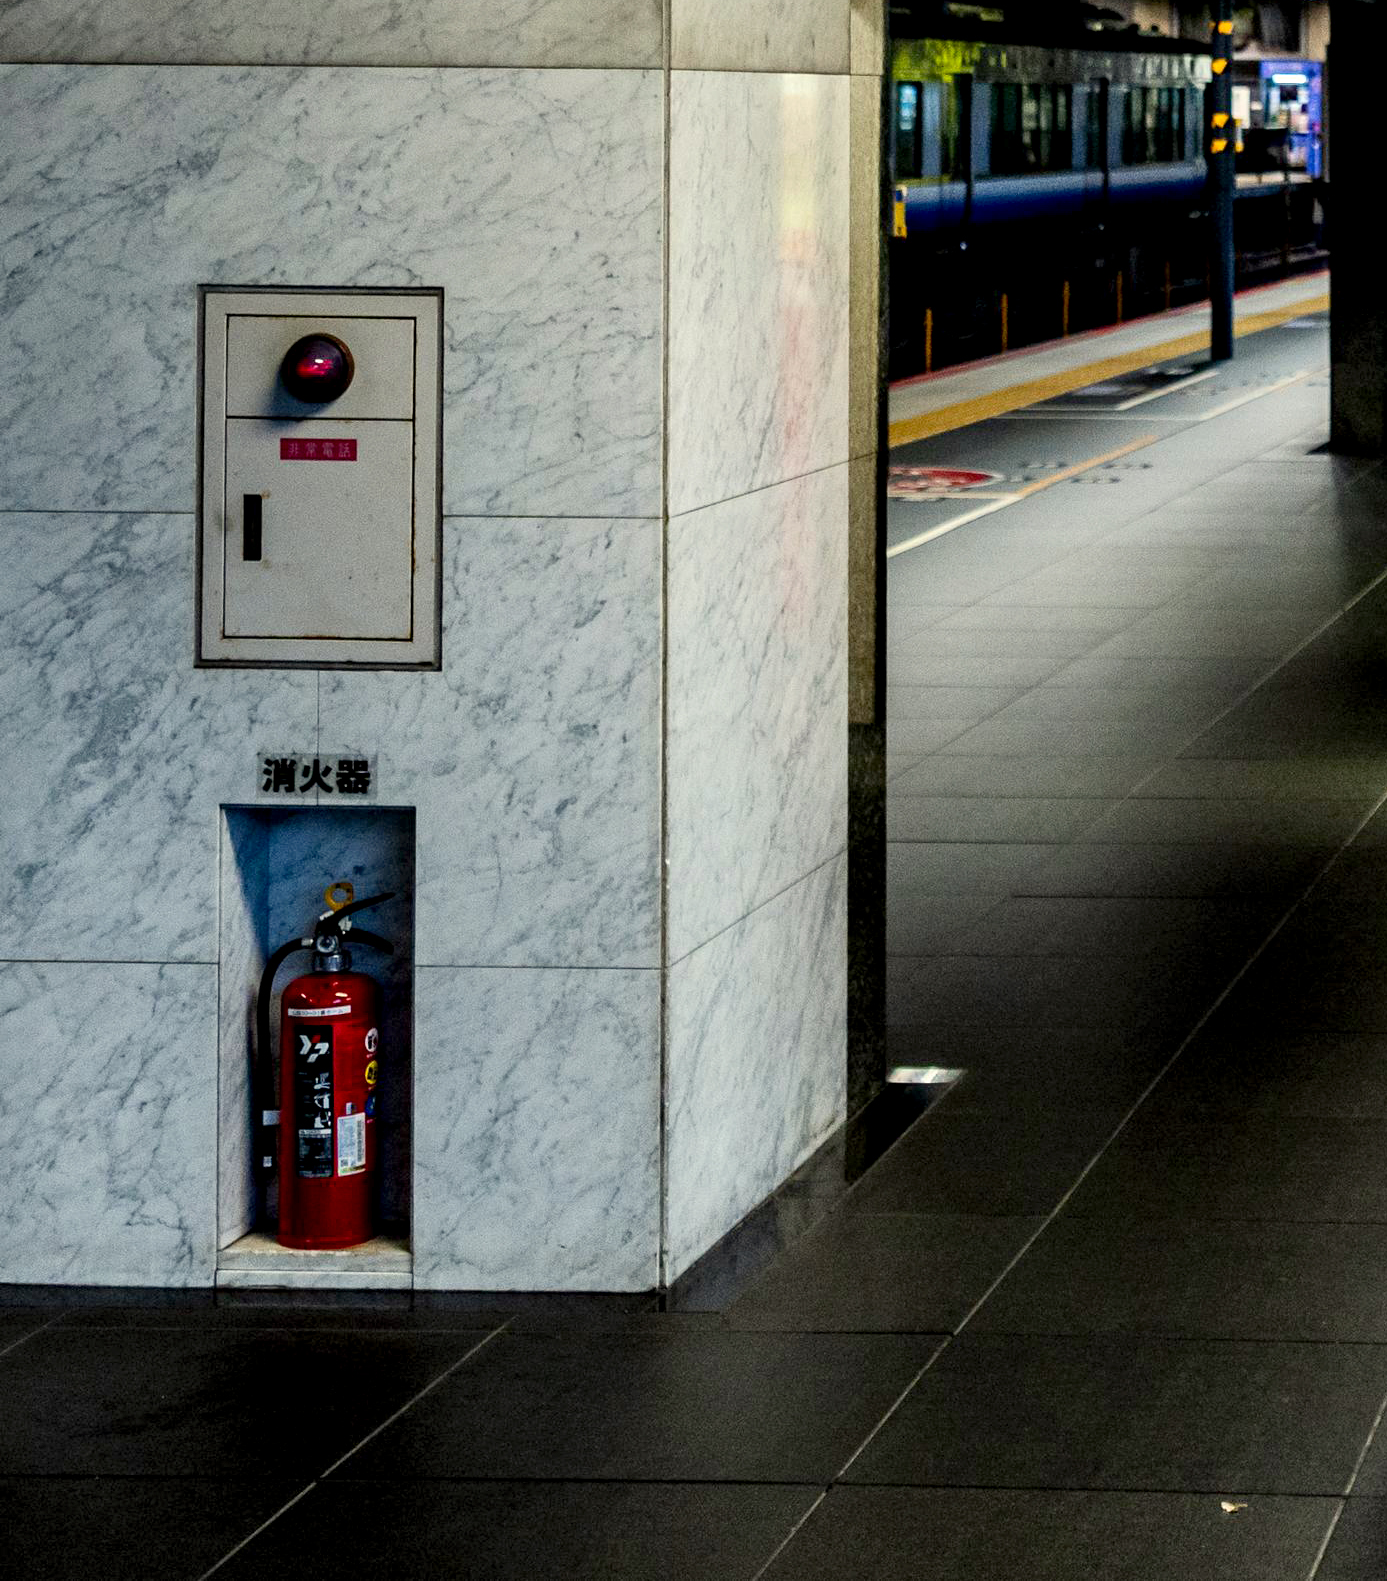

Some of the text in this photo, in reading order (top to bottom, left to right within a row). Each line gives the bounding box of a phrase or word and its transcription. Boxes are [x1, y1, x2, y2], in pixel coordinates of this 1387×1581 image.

[288, 442, 351, 458] 非常電話
[262, 758, 371, 794] 消火器
